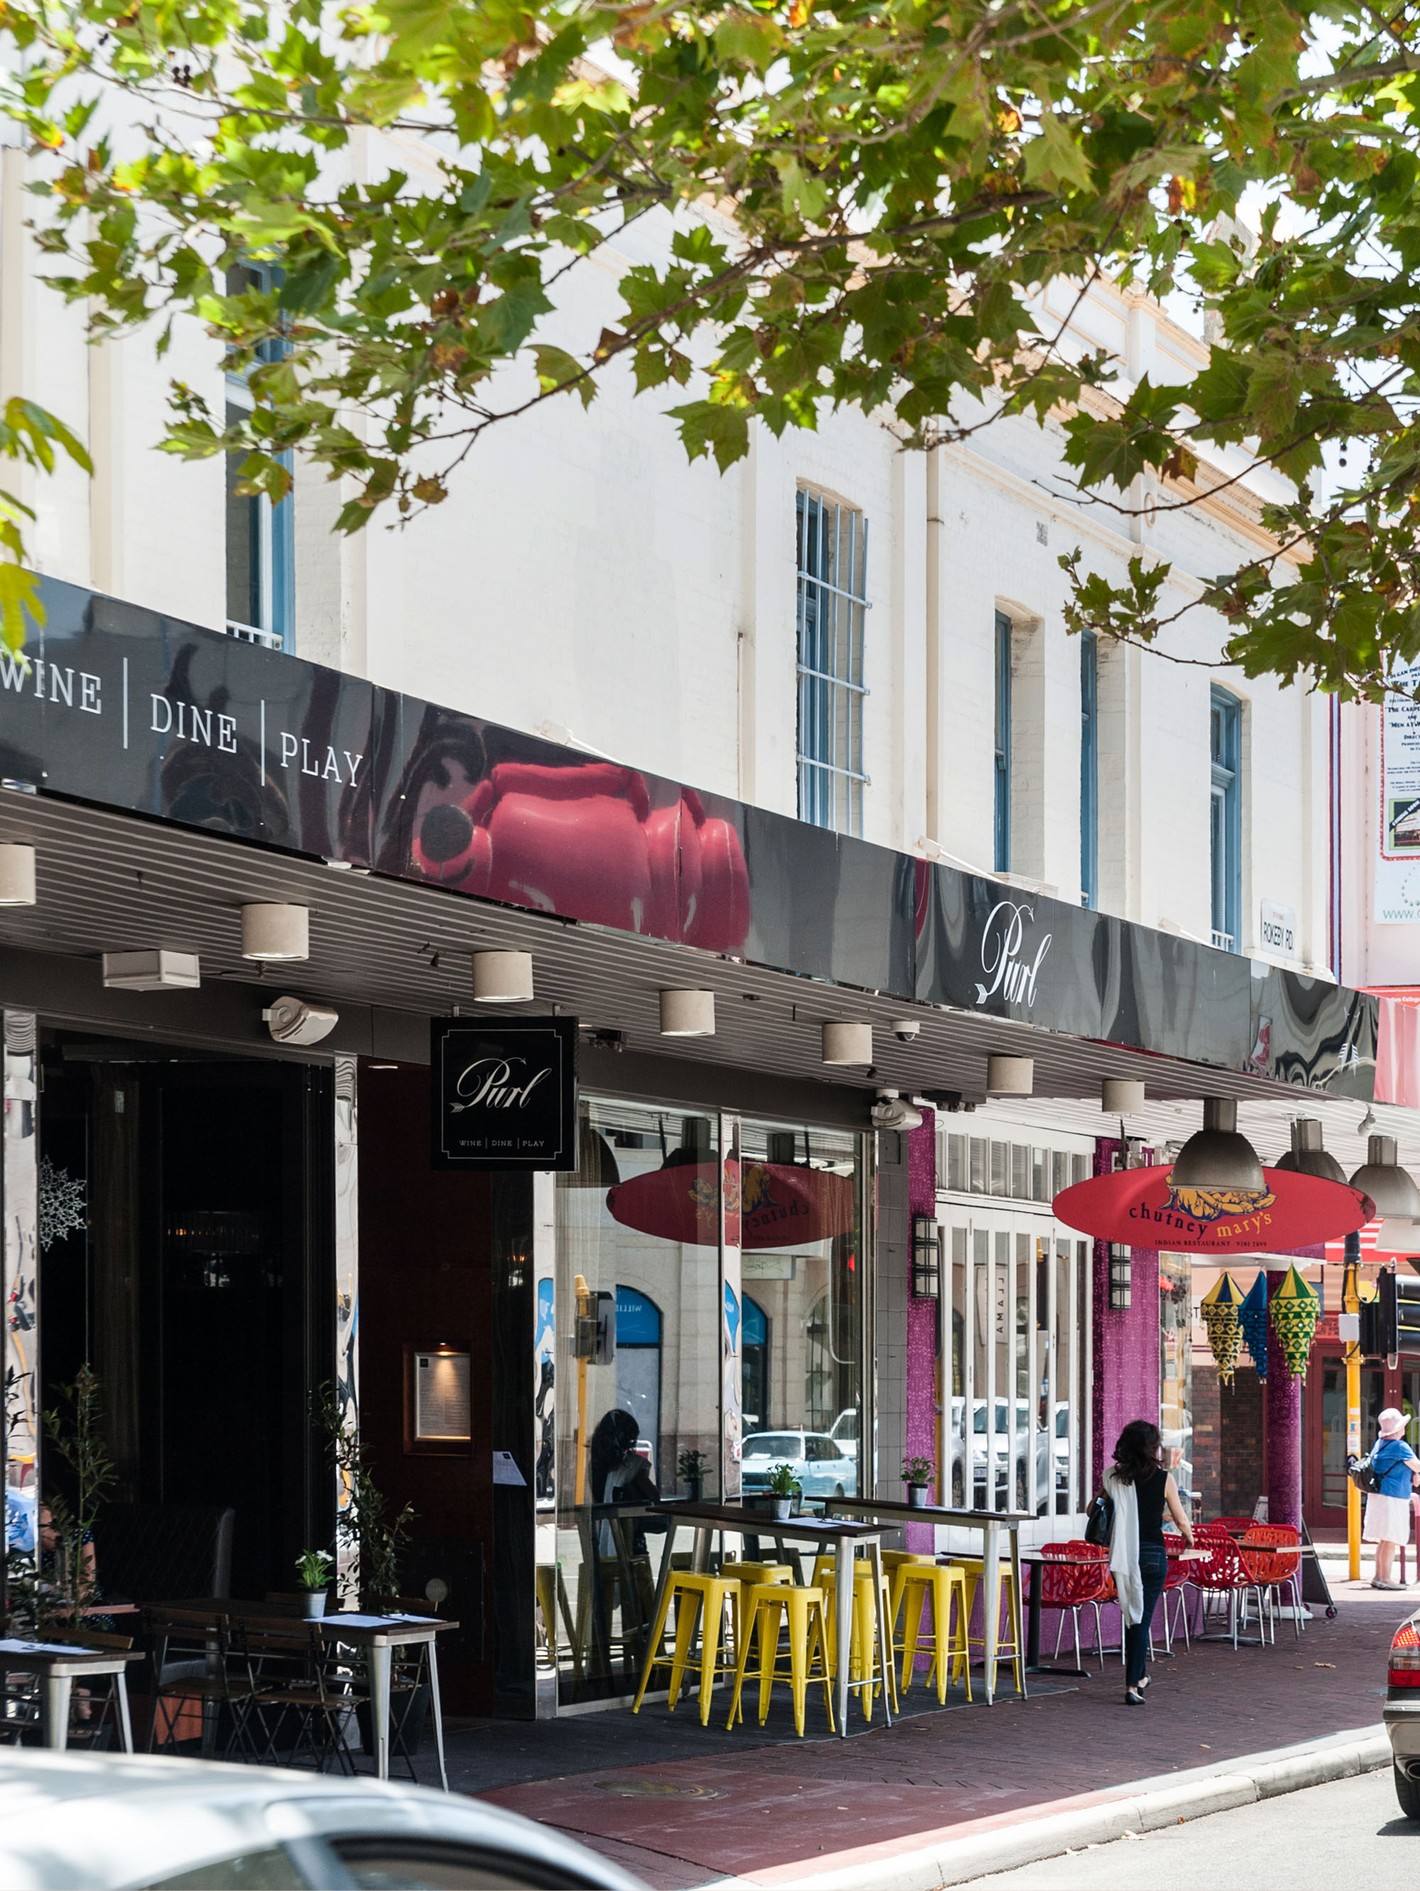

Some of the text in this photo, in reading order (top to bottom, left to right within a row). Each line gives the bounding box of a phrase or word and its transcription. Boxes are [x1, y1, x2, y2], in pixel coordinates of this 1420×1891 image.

[0, 656, 364, 788] WINE DINE PLAY
[975, 901, 1052, 1008] Purl
[449, 1057, 552, 1113] Purl
[1129, 1201, 1273, 1241] chutney mary's
[1183, 1239, 1231, 1247] RESTAURANT
